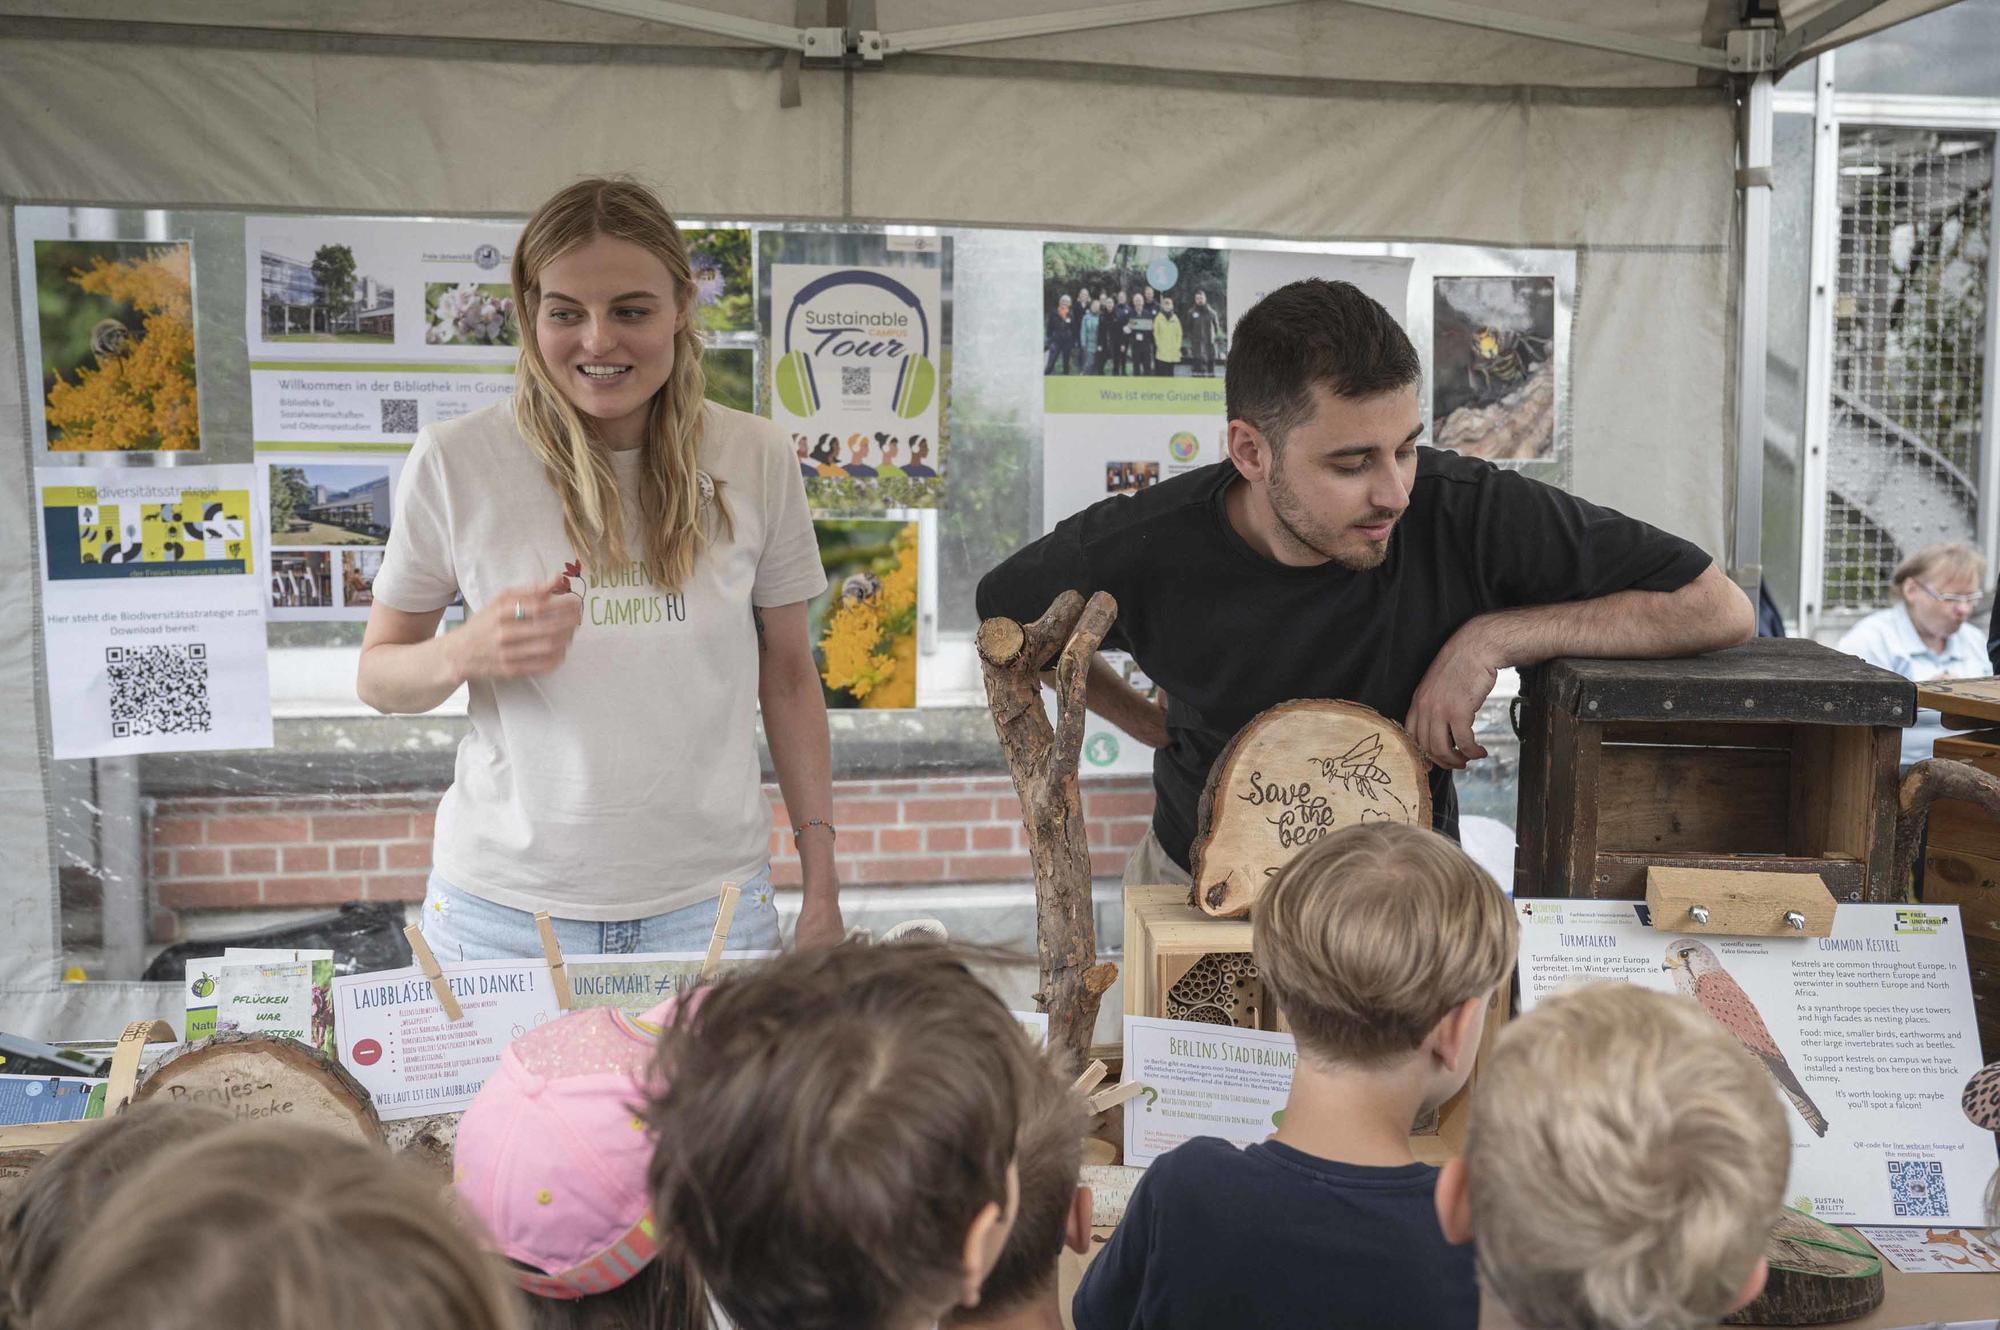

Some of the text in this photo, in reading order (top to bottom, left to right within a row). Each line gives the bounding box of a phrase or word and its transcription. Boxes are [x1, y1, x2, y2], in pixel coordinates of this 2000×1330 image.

[806, 310, 908, 326] Sustainable
[806, 327, 906, 357] Tour
[279, 380, 513, 394] Willkommen in der Bibliothek im Grüne
[1100, 390, 1122, 400] Was
[1126, 391, 1137, 400] ist
[1141, 391, 1164, 400] eine
[77, 486, 219, 498] Biodiversitätsstrategie
[591, 593, 686, 625] CAMPUS FU
[48, 609, 258, 624] Hier steht die Biodiversitätsstrategie zum
[110, 623, 198, 636] Download bereit:
[1237, 771, 1311, 806] Save
[1295, 796, 1335, 826] the
[1560, 933, 1616, 947] TURMFALKEN
[1819, 937, 1901, 952] COMMON KESTREL
[1576, 955, 1591, 963] sind
[1624, 956, 1650, 964] Europa
[1792, 960, 1821, 968] Kestrels
[1872, 962, 1916, 970] throughout
[1918, 963, 1946, 971] Europe.
[1818, 971, 1834, 979] they
[1893, 972, 1920, 980] Europe
[574, 972, 650, 996] UNGEMÄHT
[354, 980, 433, 1010] LAUBBLÄSER
[449, 977, 475, 999] EIN
[480, 973, 524, 995] DANKE
[1795, 989, 1818, 997] Africa.
[233, 994, 288, 1004] PFLÜCKEN
[1814, 1005, 1861, 1013] synanthrope
[1864, 1006, 1890, 1014] species
[1892, 1006, 1908, 1014] they
[1798, 1014, 1812, 1022] and
[1814, 1014, 1832, 1023] high
[1834, 1014, 1862, 1022] facades
[1875, 1016, 1902, 1024] nesting
[1905, 1016, 1930, 1024] places.
[192, 1020, 217, 1031] Natu
[261, 1030, 304, 1038] ESTERN.
[1824, 1030, 1844, 1038] mice,
[1846, 1030, 1874, 1038] smaller
[1876, 1031, 1897, 1039] birds,
[1900, 1031, 1945, 1039] earthworms
[1824, 1040, 1842, 1048] large
[1845, 1040, 1894, 1048] invertebrates
[1926, 1041, 1955, 1049] beetles.
[1170, 1037, 1297, 1069] BERLINS STADTBÄUME
[1804, 1054, 1812, 1062] To
[1814, 1055, 1844, 1064] support
[1846, 1055, 1874, 1063] kestrels
[1934, 1056, 1951, 1064] have
[1805, 1064, 1836, 1072] installed
[1845, 1065, 1874, 1074] nesting
[1876, 1065, 1890, 1073] box
[1940, 1066, 1958, 1074] brick
[1806, 1074, 1840, 1083] chimney.
[376, 1093, 391, 1106] WIE
[393, 1091, 410, 1104] LAUT
[412, 1090, 424, 1101] IST
[426, 1088, 440, 1100] EIN
[1873, 1091, 1901, 1100] looking
[1904, 1092, 1916, 1100] up:
[1919, 1092, 1944, 1100] maybe
[235, 1099, 293, 1122] Hecke
[1848, 1101, 1868, 1109] you'll
[1871, 1102, 1887, 1110] spot
[1933, 1143, 1957, 1151] footage
